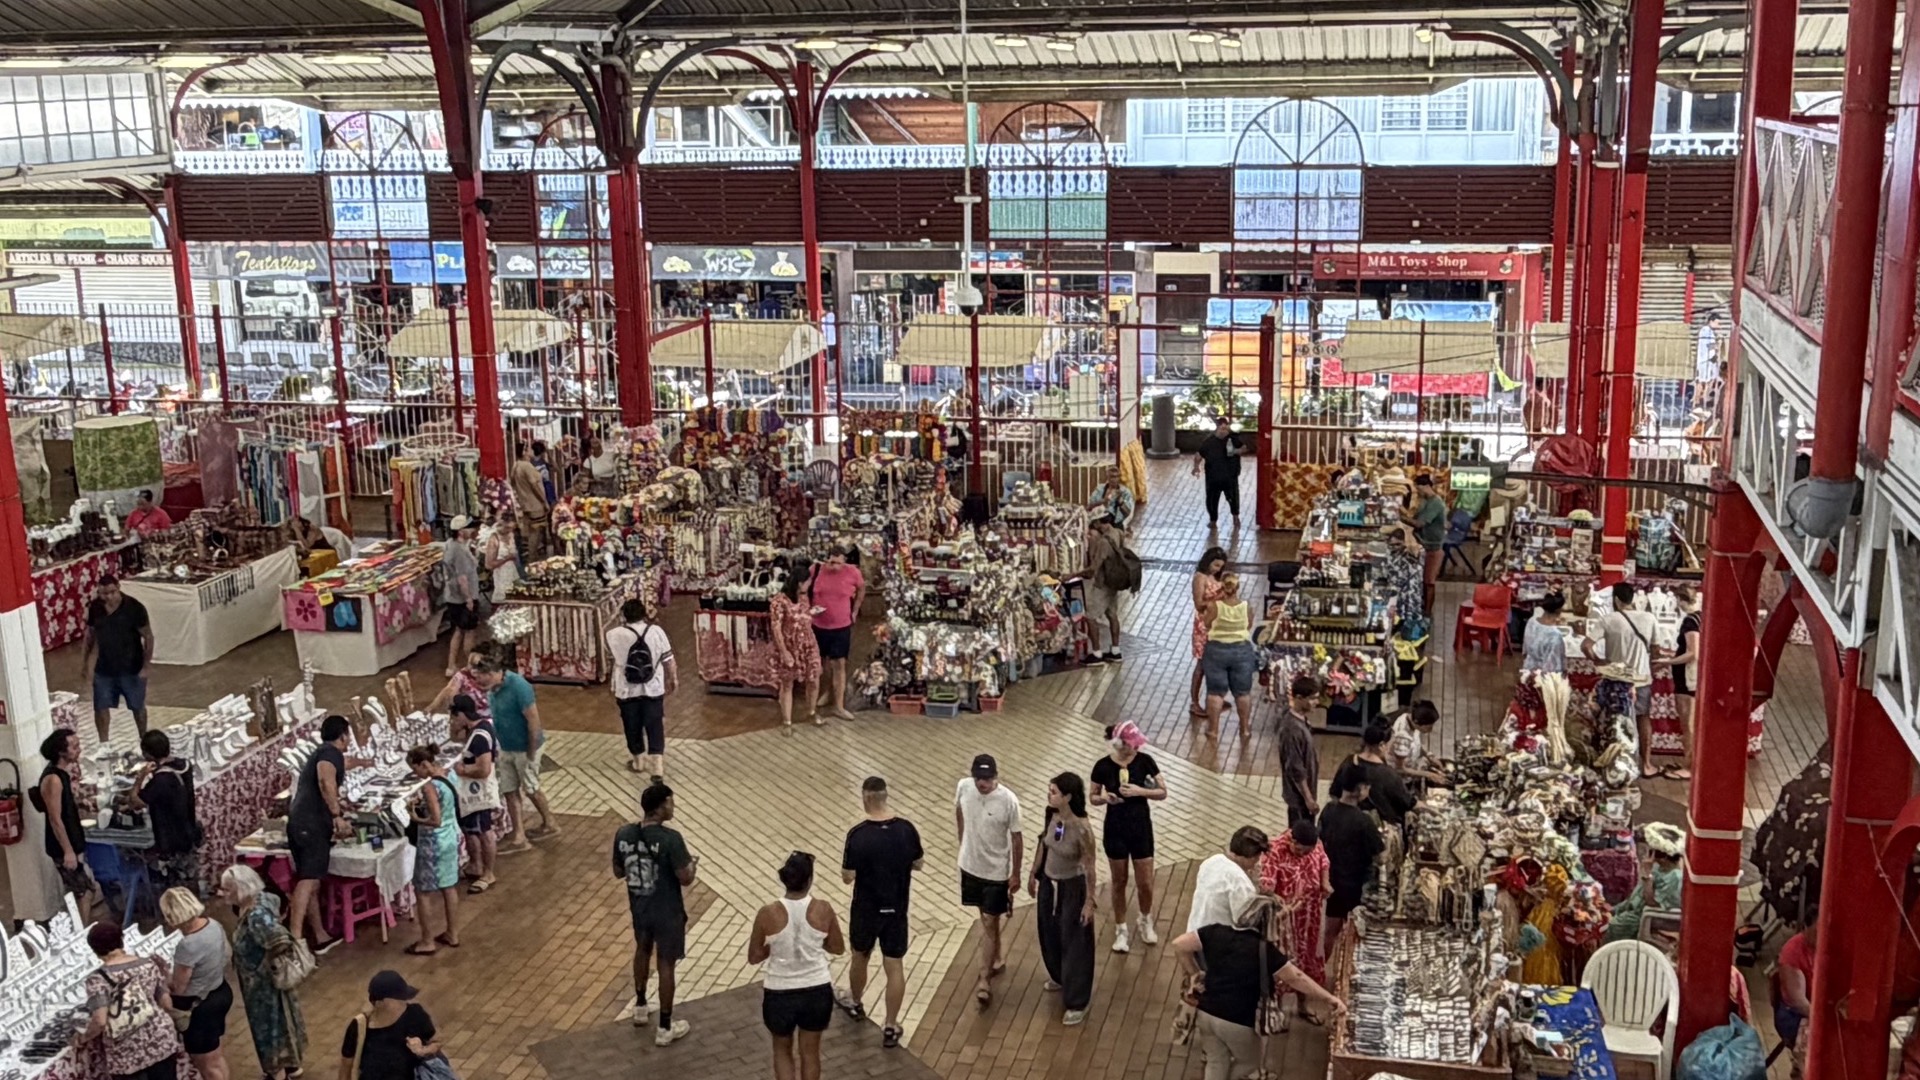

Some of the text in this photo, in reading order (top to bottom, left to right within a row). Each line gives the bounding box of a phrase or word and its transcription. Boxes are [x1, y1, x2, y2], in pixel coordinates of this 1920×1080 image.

[8, 252, 52, 265] ARTICLES
[53, 253, 66, 265] DE
[104, 253, 140, 265] CHASSE
[141, 254, 165, 266] SOUS
[235, 250, 317, 271] Tentations
[1367, 255, 1397, 268] M&L
[1400, 255, 1428, 269] Toys
[1436, 255, 1468, 269] Shop
